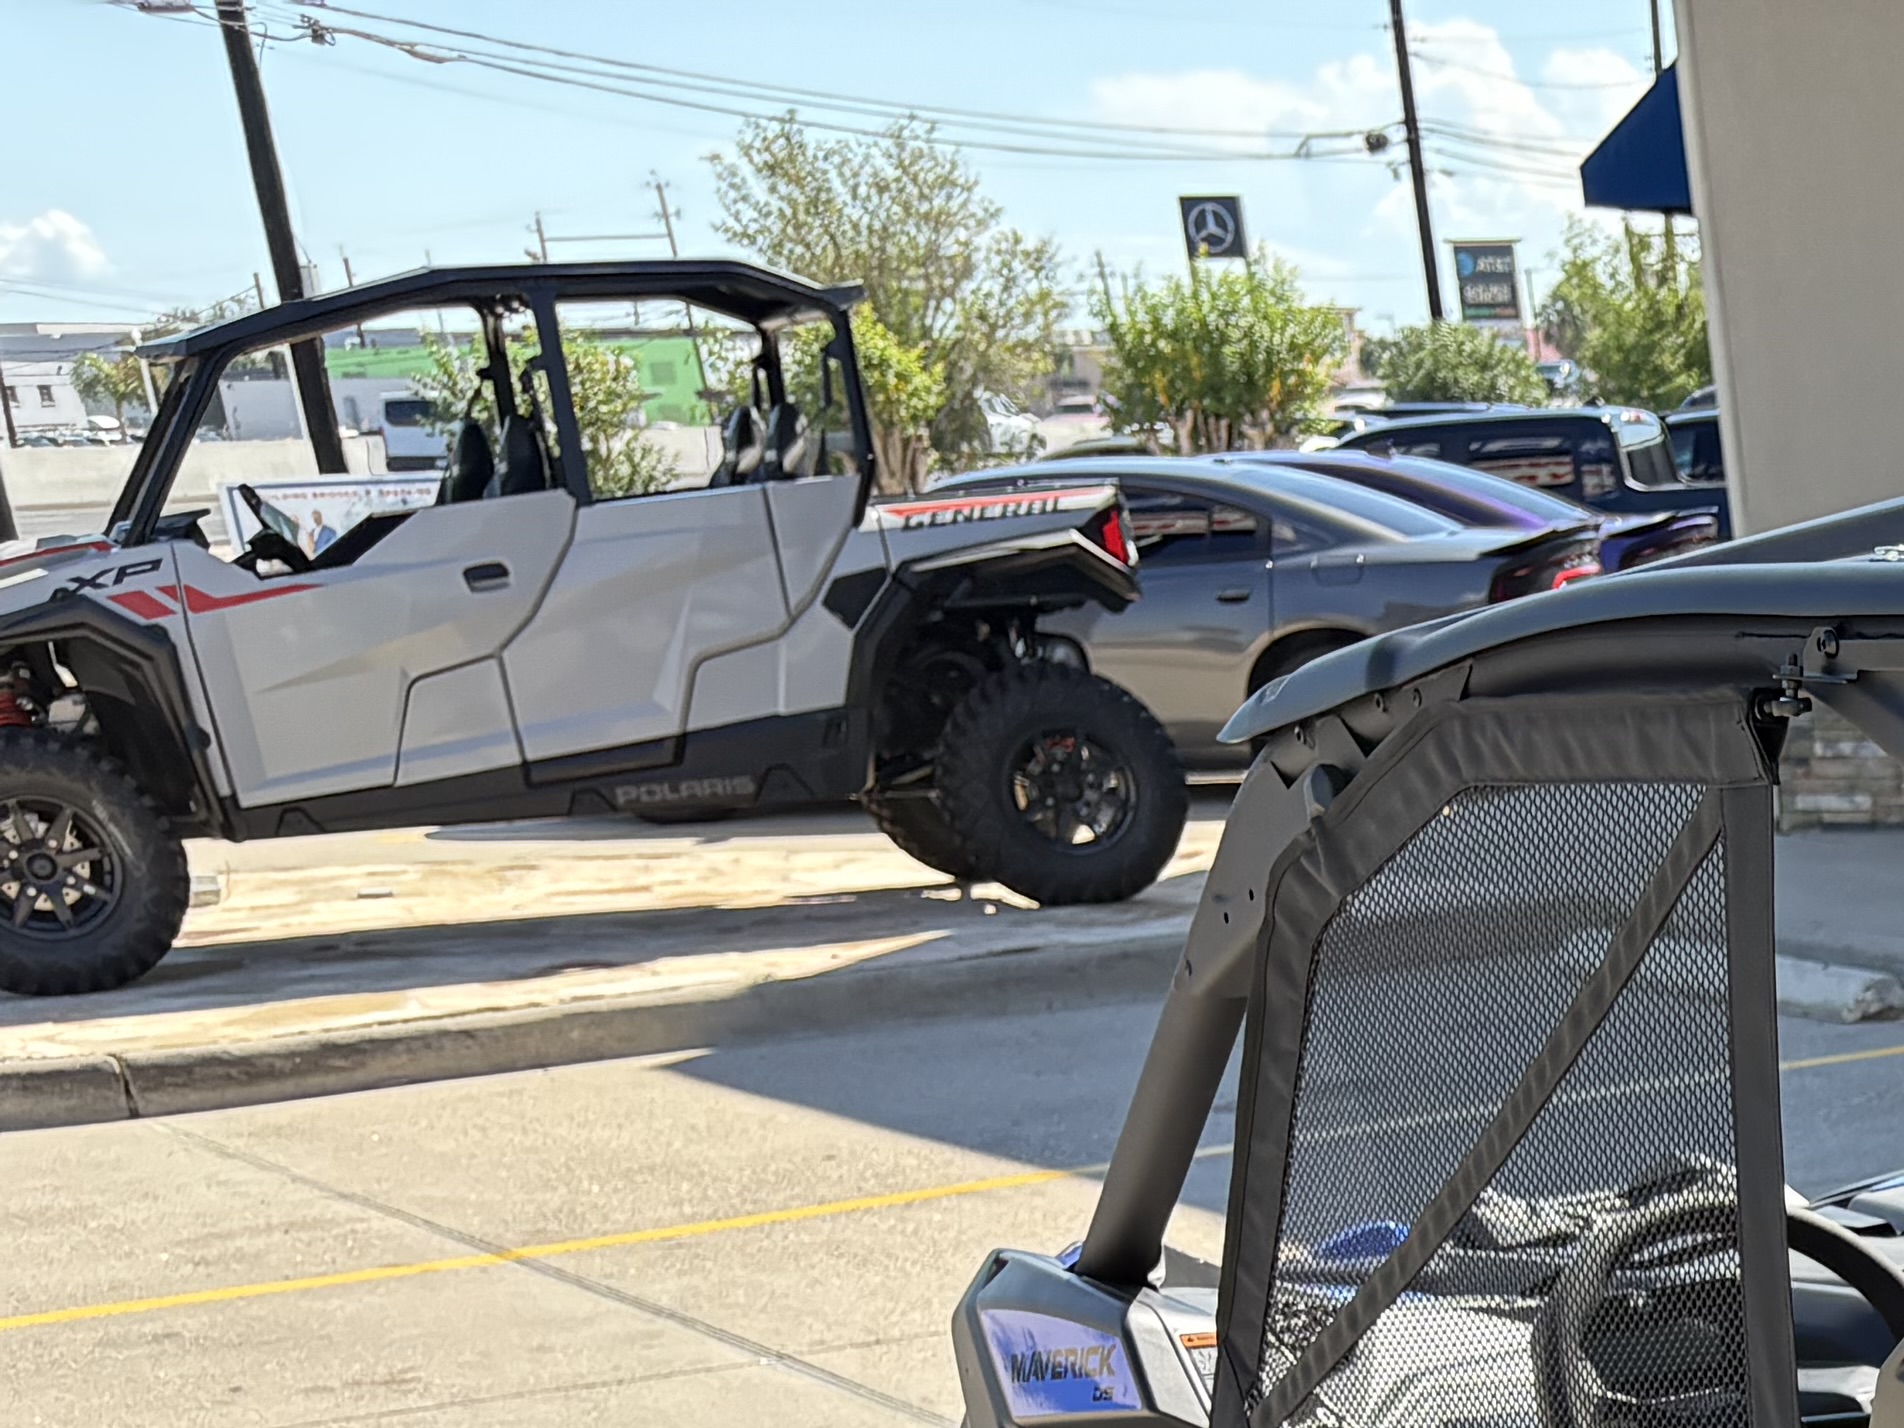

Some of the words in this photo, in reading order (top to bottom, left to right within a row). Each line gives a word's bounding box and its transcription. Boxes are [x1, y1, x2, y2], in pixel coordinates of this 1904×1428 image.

[904, 497, 1060, 530] GENERAL
[67, 558, 163, 594] XP
[614, 775, 756, 804] POLARIS
[1010, 1344, 1117, 1384] MAVERICK
